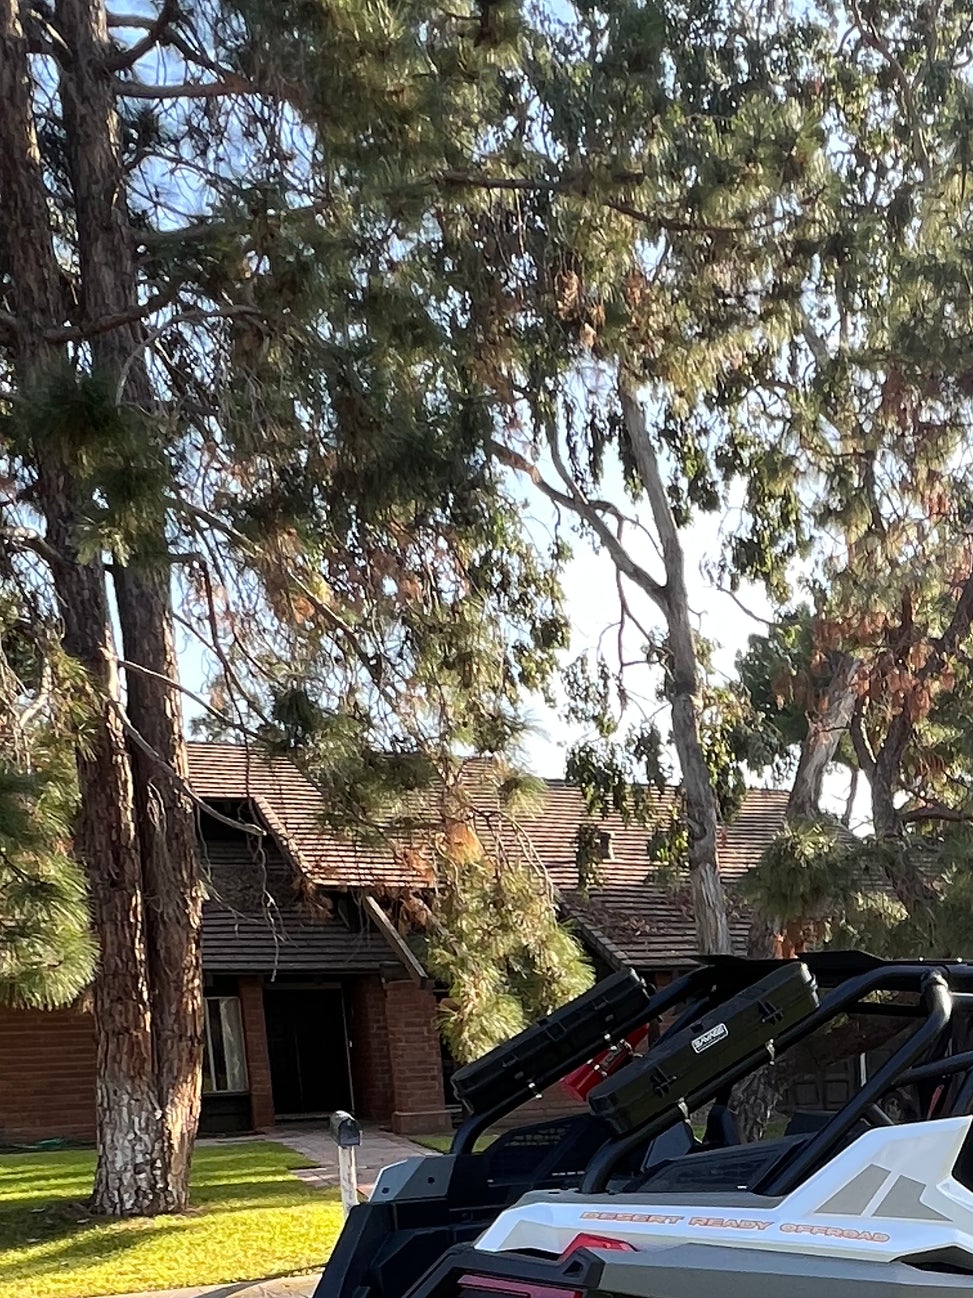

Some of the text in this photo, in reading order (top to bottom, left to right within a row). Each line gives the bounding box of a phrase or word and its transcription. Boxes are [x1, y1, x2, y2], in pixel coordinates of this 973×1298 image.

[580, 1212, 890, 1243] DESERT READY OFFROAD
